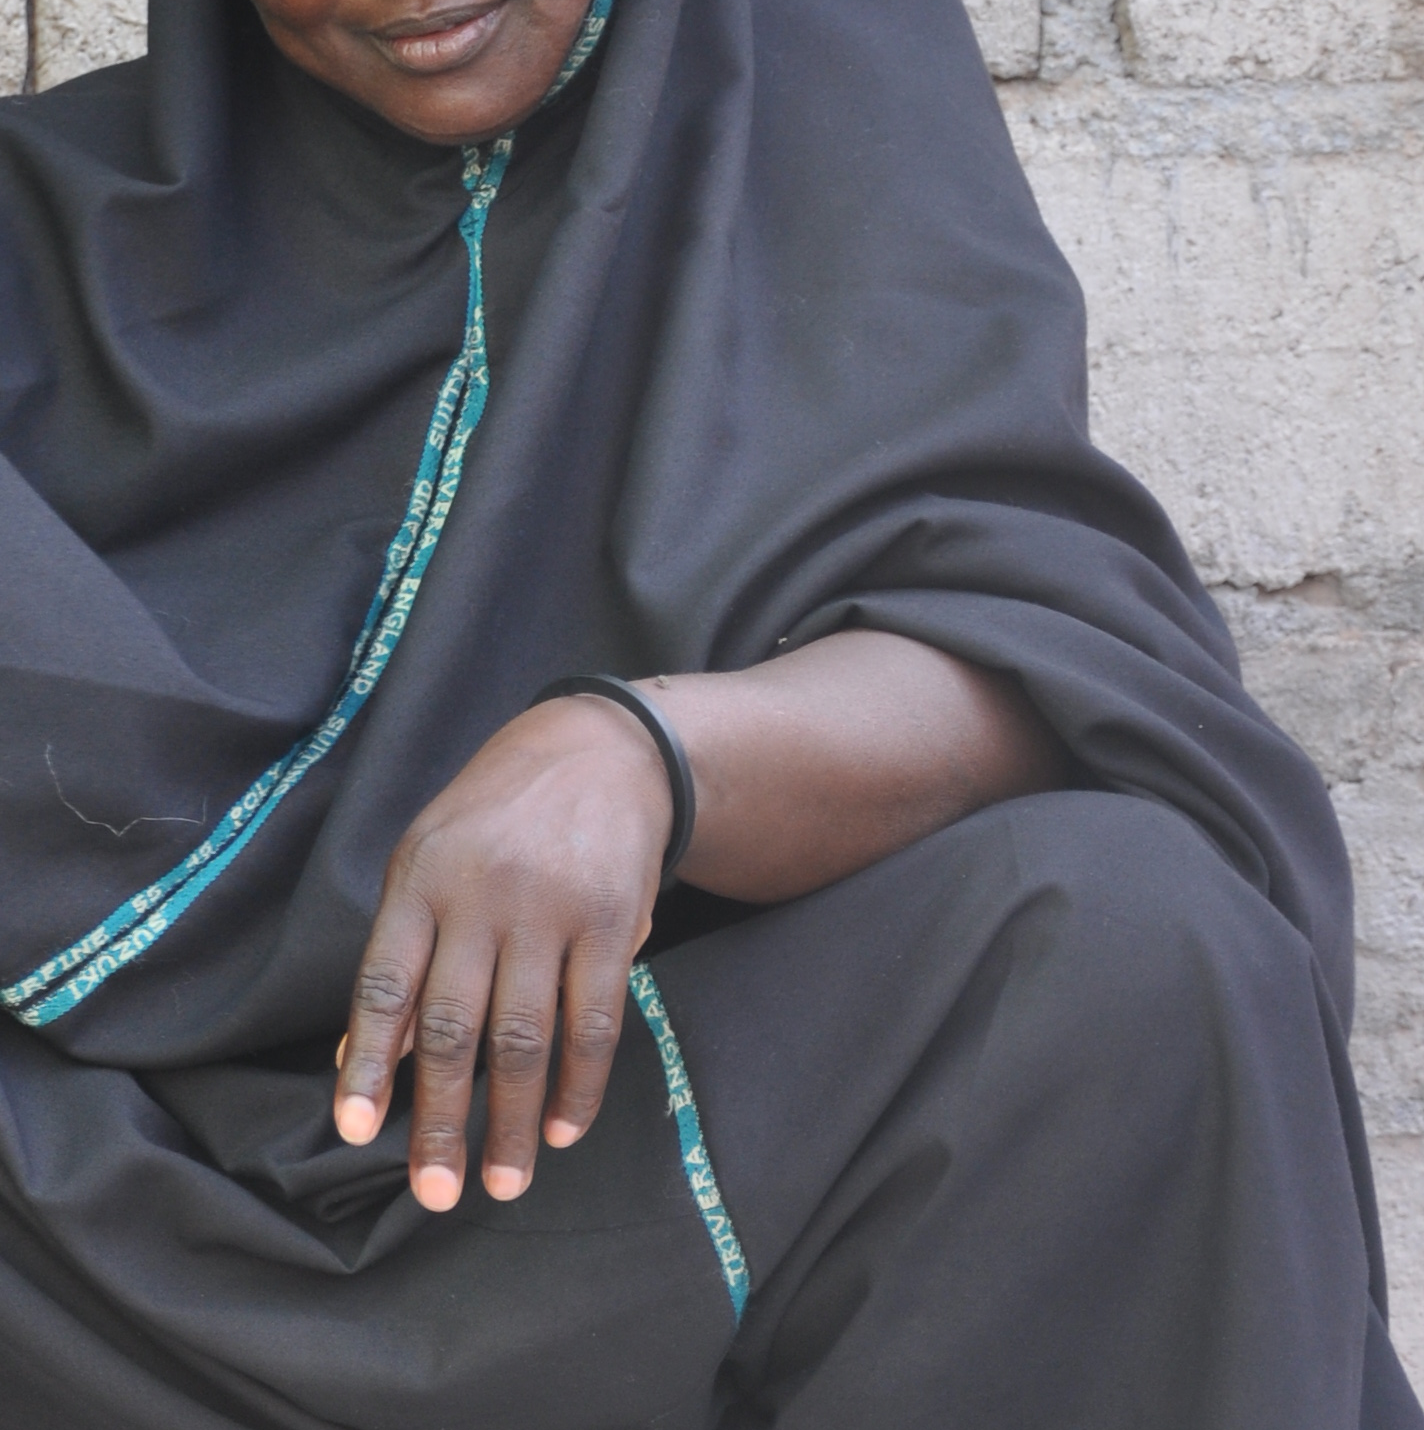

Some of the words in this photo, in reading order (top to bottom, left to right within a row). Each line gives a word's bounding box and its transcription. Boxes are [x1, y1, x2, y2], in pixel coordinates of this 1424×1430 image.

[353, 577, 422, 696] ENGLAND
[231, 761, 282, 828] POLY
[272, 715, 346, 799] SUITING
[69, 912, 168, 1002] SUZUKI
[686, 1145, 747, 1287] TRIVERA
